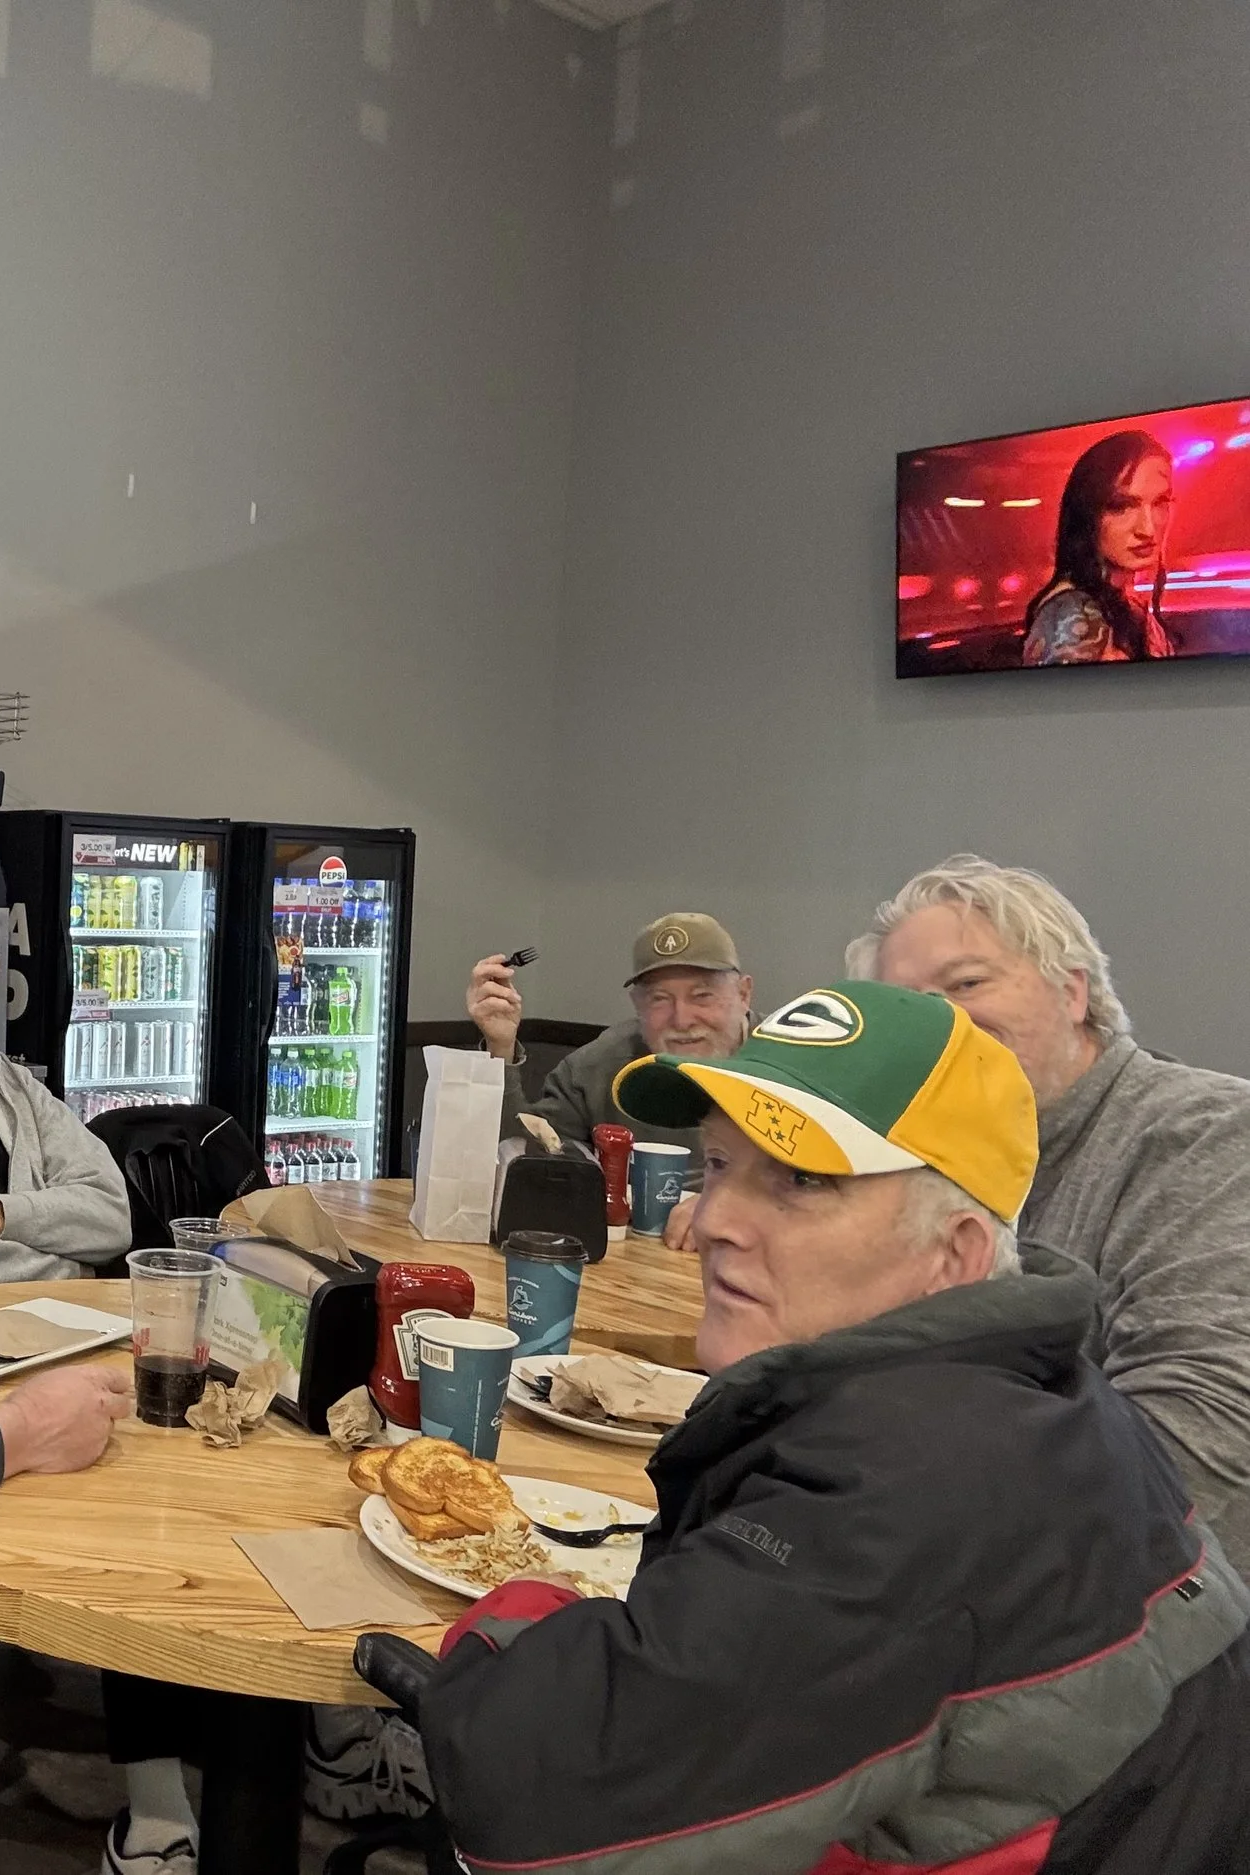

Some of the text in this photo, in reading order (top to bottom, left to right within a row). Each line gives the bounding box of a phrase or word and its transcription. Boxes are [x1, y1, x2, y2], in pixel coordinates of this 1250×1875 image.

[114, 843, 178, 863] at's NEW
[321, 871, 345, 880] PEPSI
